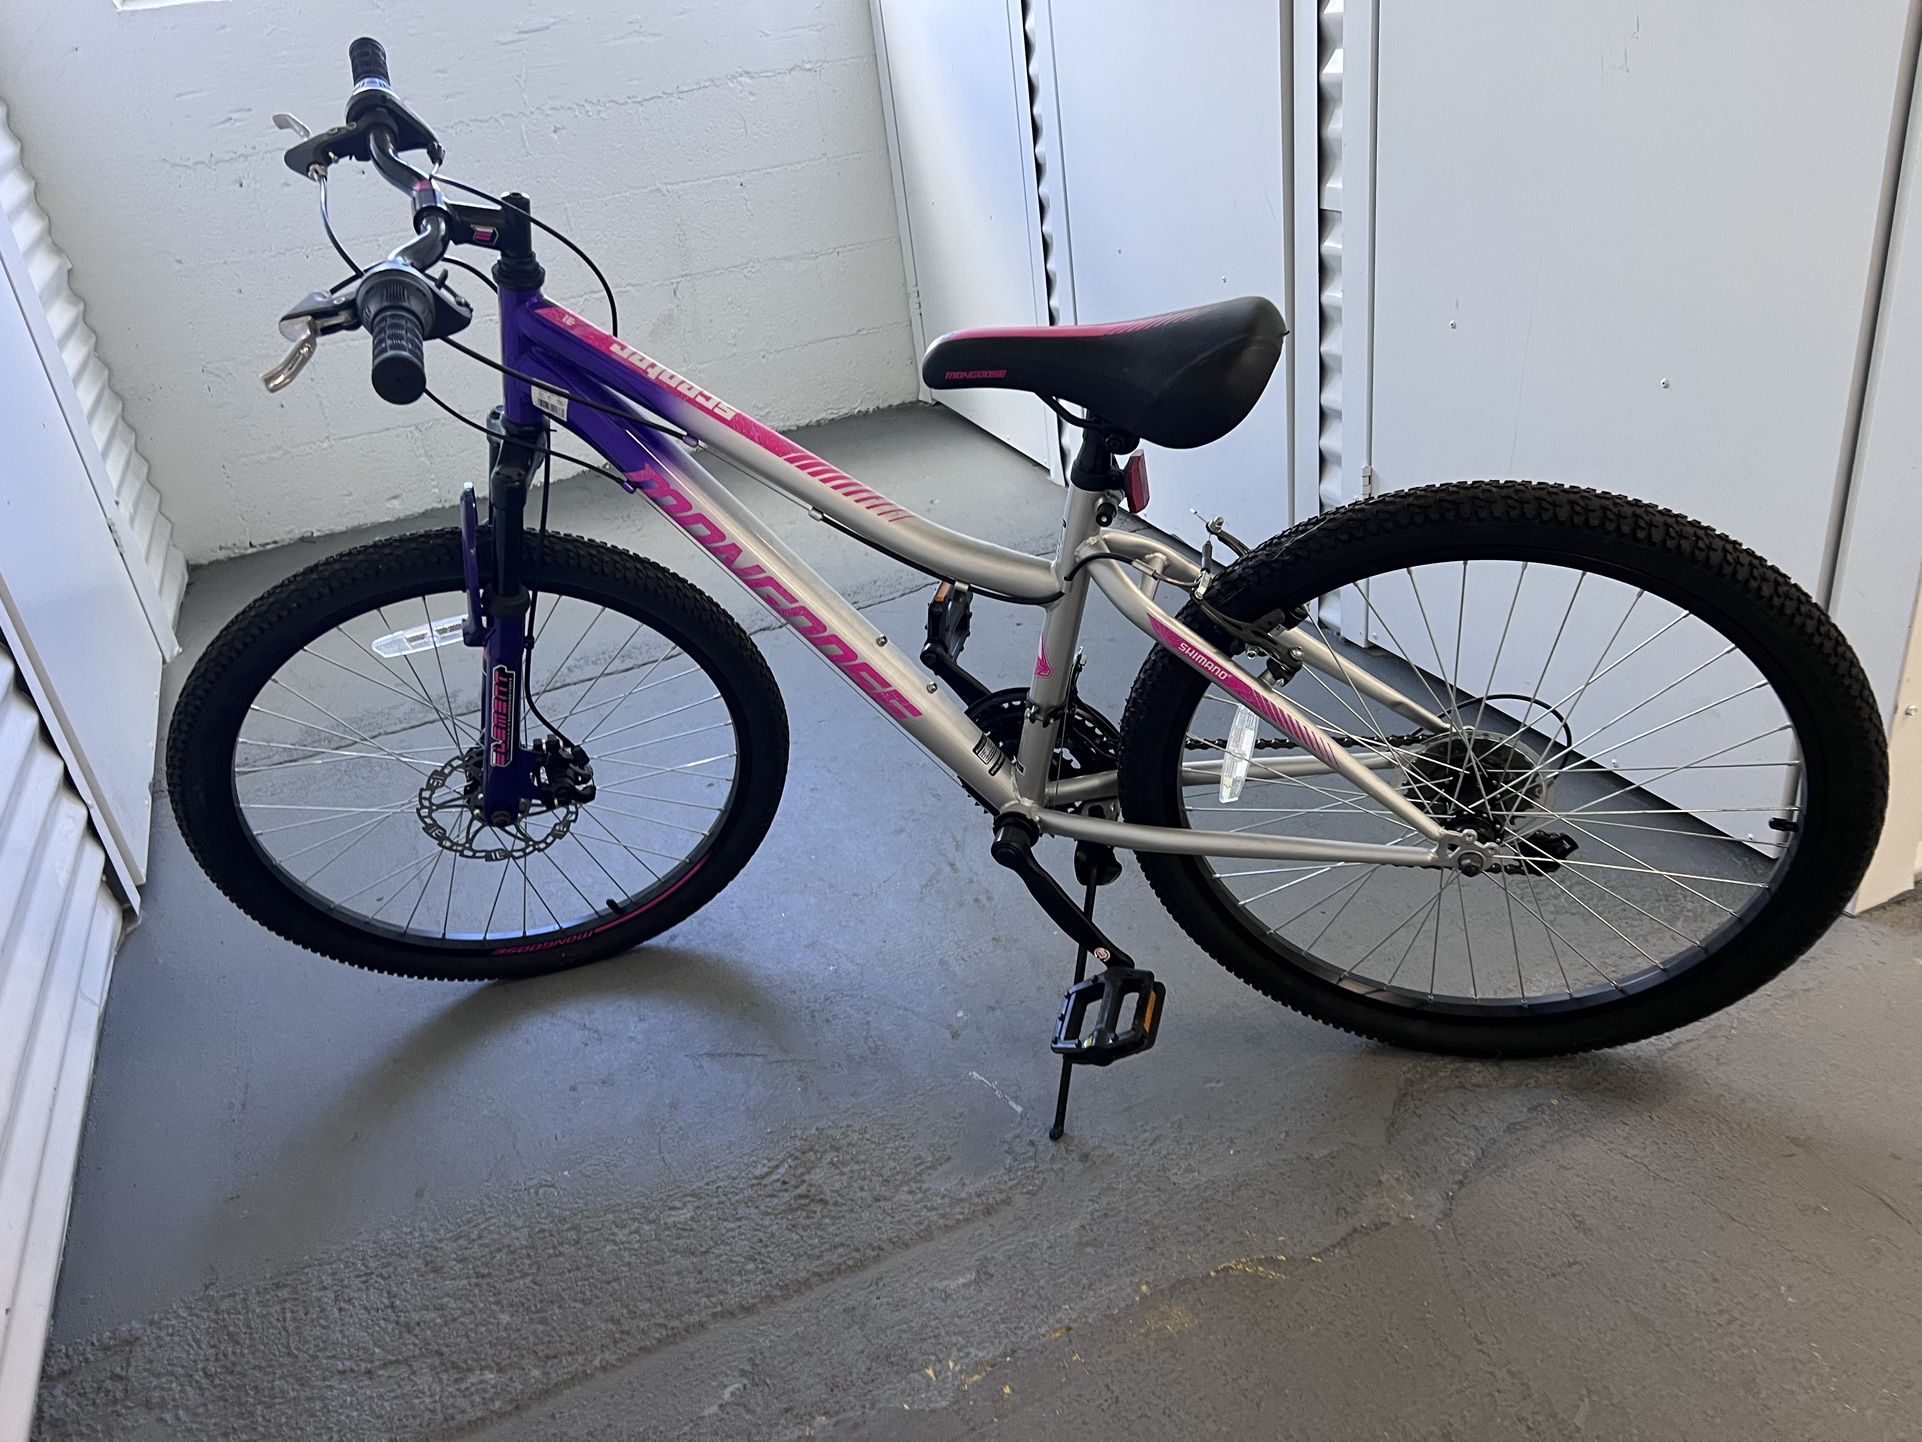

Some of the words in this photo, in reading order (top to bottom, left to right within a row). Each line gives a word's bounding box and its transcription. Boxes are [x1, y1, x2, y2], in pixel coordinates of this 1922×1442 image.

[945, 369, 1008, 380] MONGOOSE
[627, 463, 923, 720] MONGOOSE
[1178, 642, 1229, 680] SHIMANO
[492, 670, 508, 765] ELEMENT
